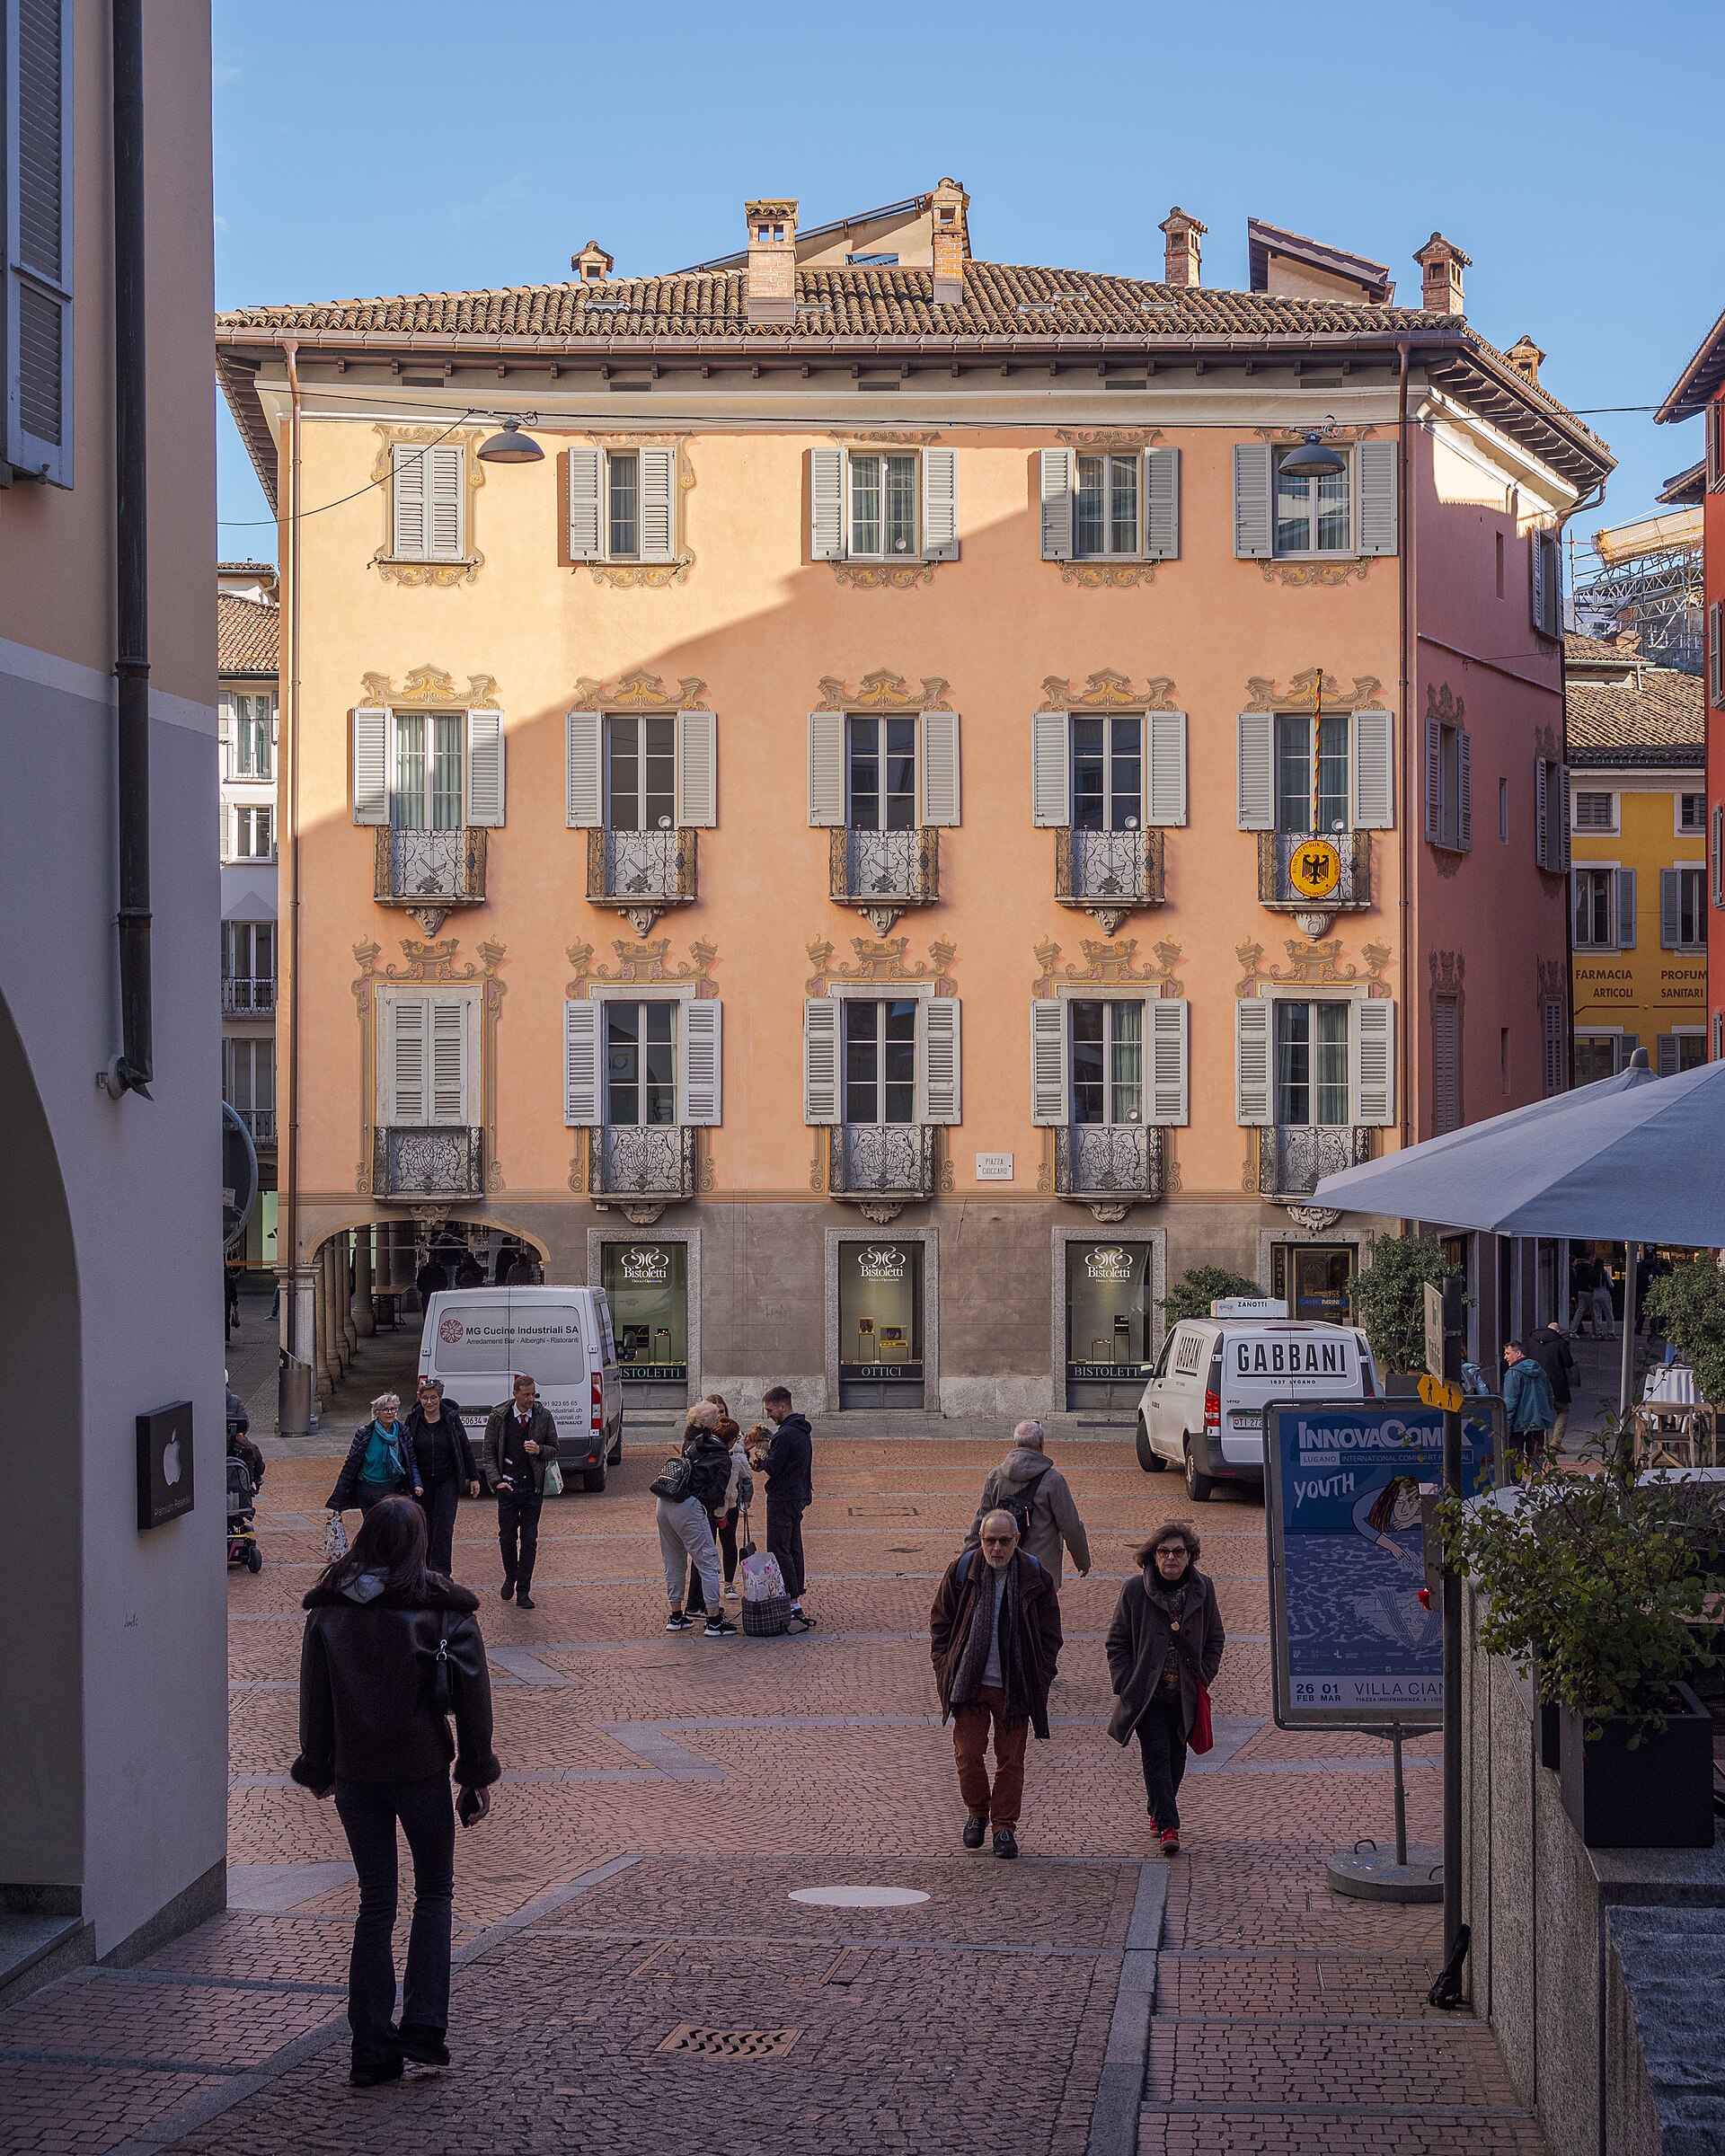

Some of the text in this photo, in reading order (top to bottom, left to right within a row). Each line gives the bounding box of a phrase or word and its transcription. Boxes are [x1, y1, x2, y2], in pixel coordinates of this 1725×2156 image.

[1575, 969, 1633, 980] FARMACIA
[1593, 987, 1703, 998] ARTICOLI SANITARI
[982, 1167, 1008, 1175] CIOCCARO
[624, 1266, 667, 1278] Bistoletti
[860, 1265, 904, 1277] Bistoletti
[1086, 1266, 1131, 1278] Bistoletti
[465, 1325, 579, 1335] MG Cucine Industriali SA
[520, 1337, 545, 1345] Alberghi
[1236, 1342, 1346, 1373] GABBANI
[620, 1367, 680, 1378] ISTOLETTI
[861, 1366, 902, 1377] OTTICI
[1075, 1366, 1140, 1376] BISTOLETT
[1304, 1455, 1337, 1463] LUGANO
[1342, 1454, 1395, 1462] INTERNATIONAL
[1398, 1454, 1422, 1462] COMI
[1294, 1471, 1355, 1508] YOUTH
[1296, 1683, 1339, 1694] 26 01
[1354, 1683, 1403, 1695] VILLA
